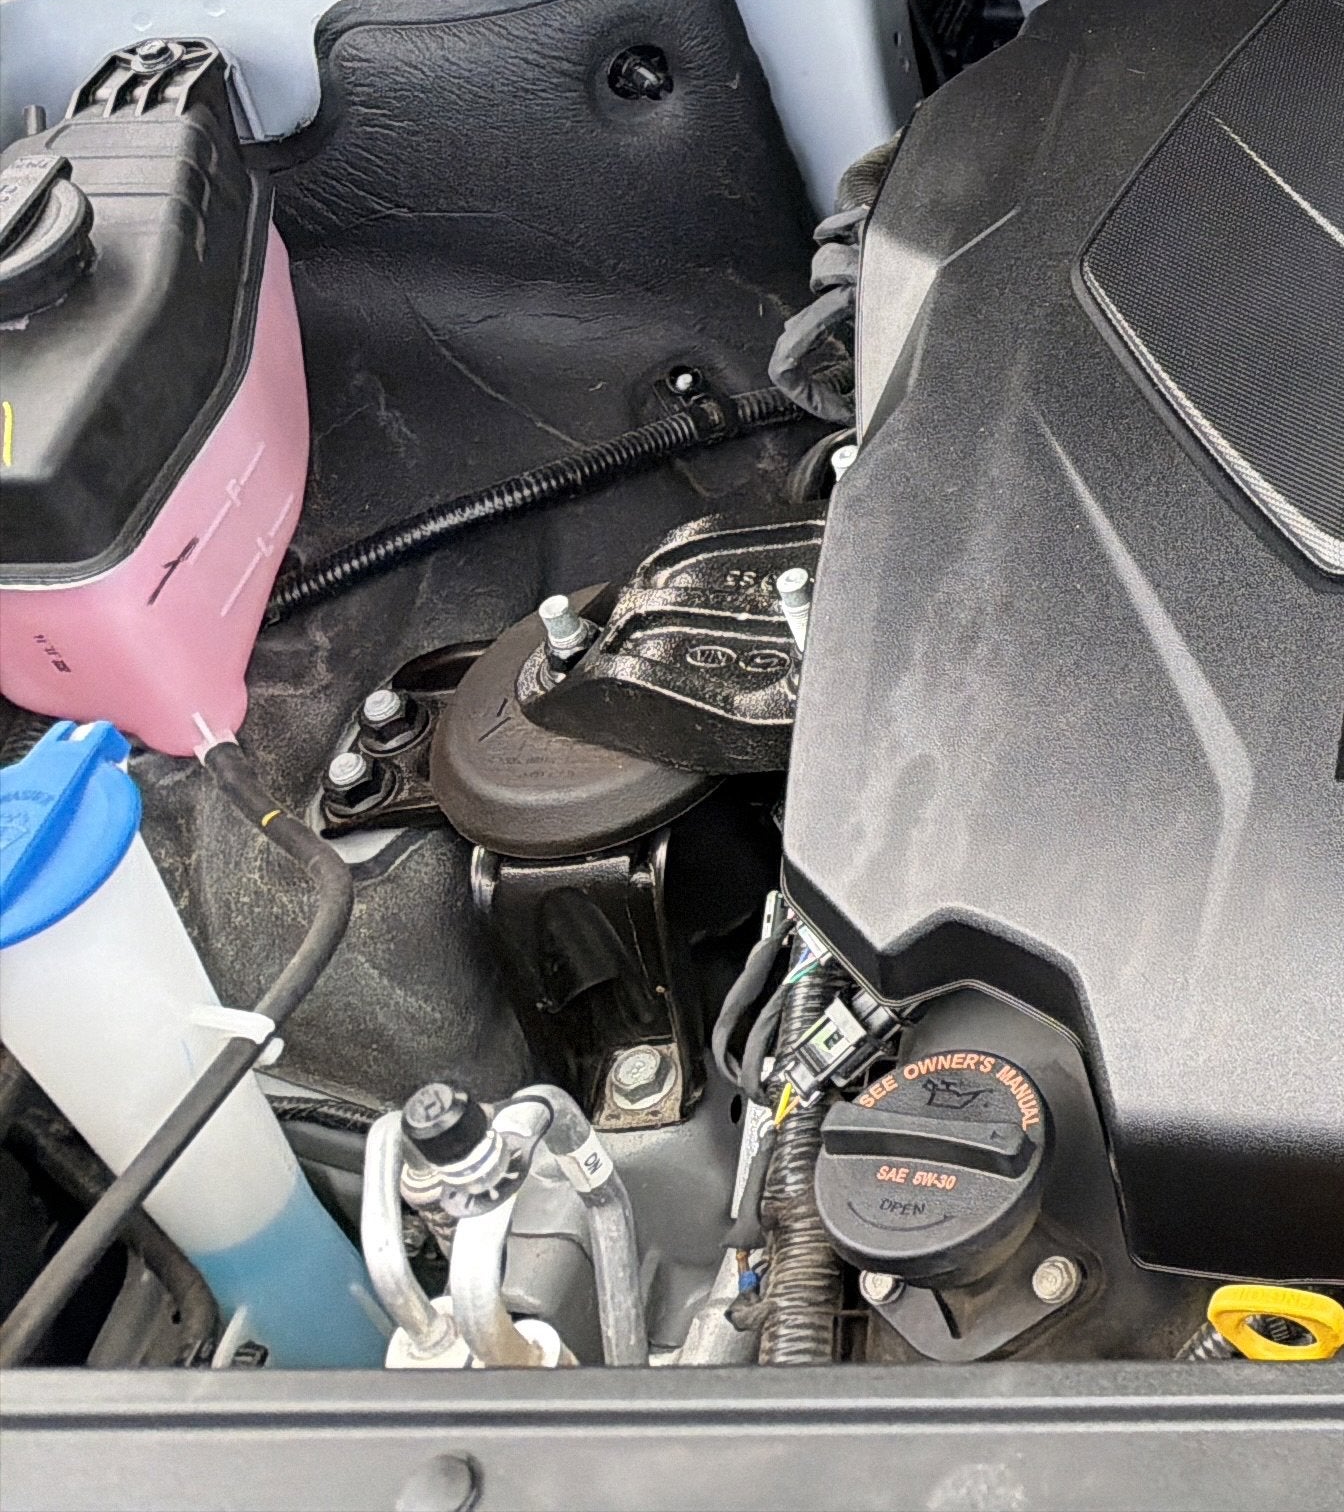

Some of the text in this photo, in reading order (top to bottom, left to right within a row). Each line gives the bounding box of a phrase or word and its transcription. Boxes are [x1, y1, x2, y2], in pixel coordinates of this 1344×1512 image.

[858, 1052, 1041, 1132] SEE OWNER'S MANUAL
[875, 1164, 957, 1191] SAE 5W-30
[878, 1197, 926, 1216] OPEN
